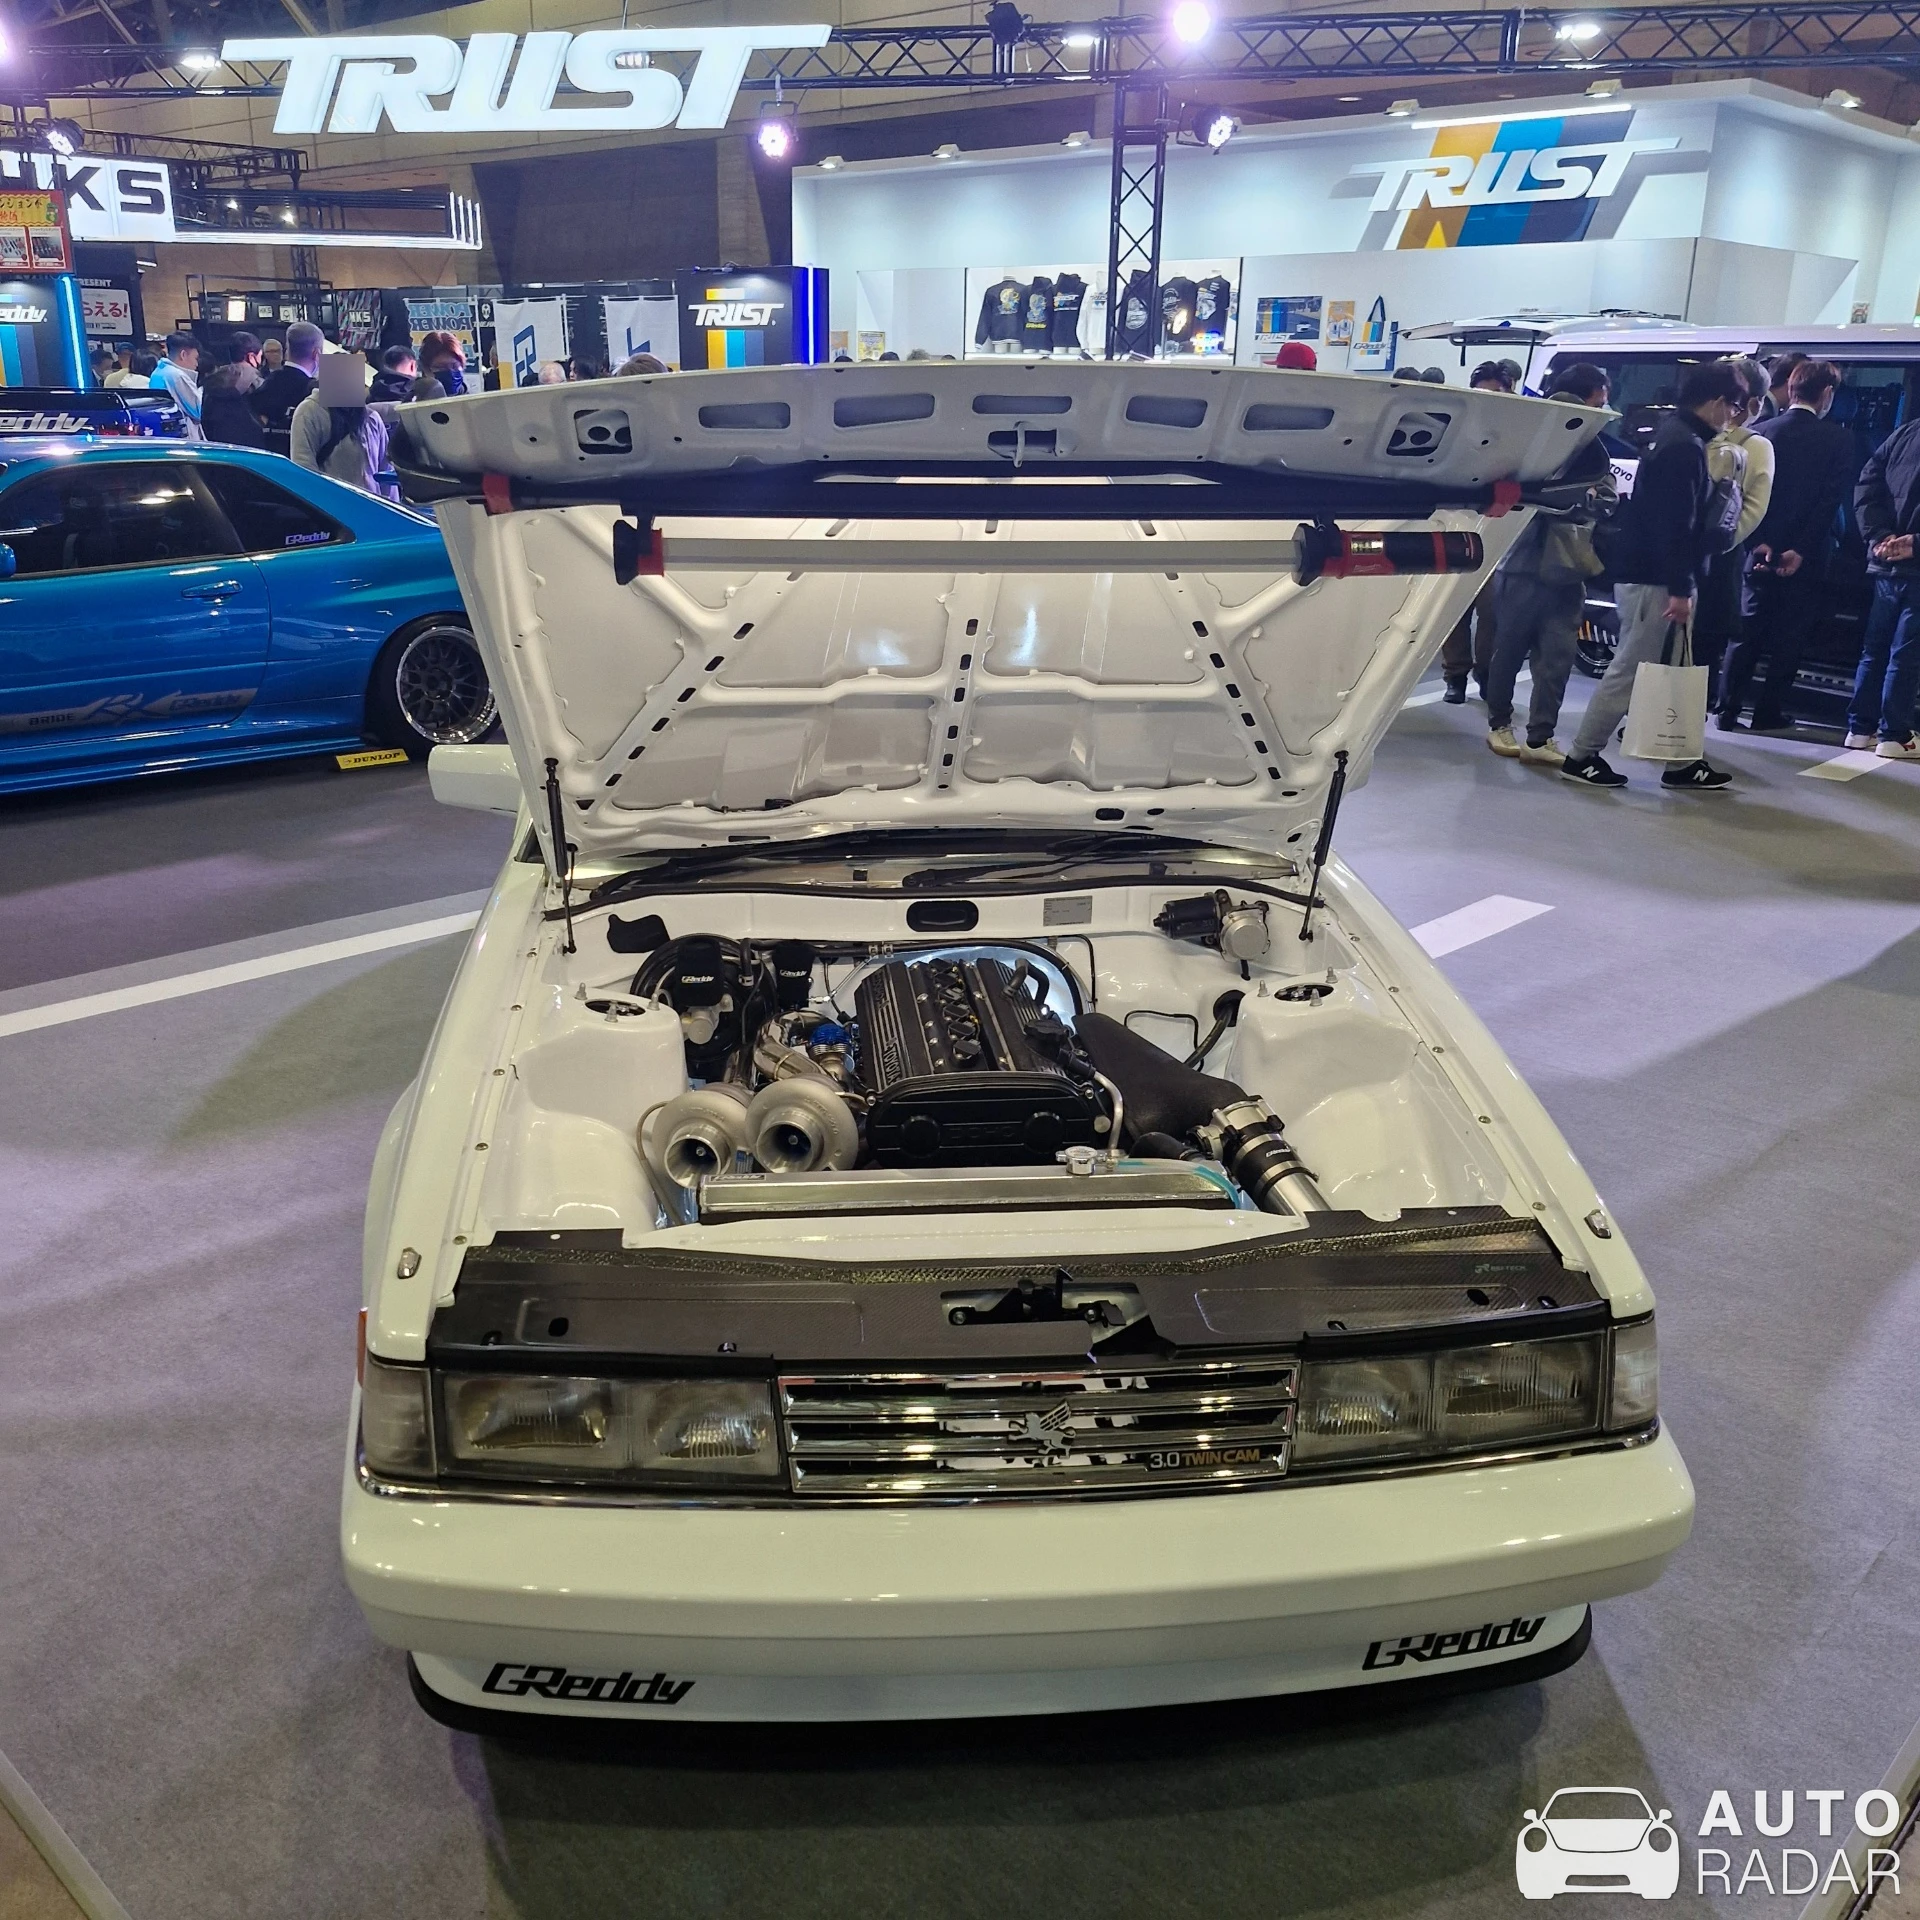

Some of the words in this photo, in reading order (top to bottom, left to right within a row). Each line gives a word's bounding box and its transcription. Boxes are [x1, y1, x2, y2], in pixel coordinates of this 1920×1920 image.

[221, 24, 832, 134] TRUST
[1350, 137, 1681, 212] TRUST
[688, 303, 784, 327] TRUST
[1610, 463, 1633, 482] TOYO
[285, 531, 330, 546] GReddy
[29, 712, 76, 727] BRIDE
[353, 752, 400, 764] DUNLOP
[681, 975, 715, 984] GReddy
[1149, 1451, 1180, 1469] 3.0
[1181, 1451, 1221, 1466] TWIN
[1222, 1448, 1260, 1463] CAM
[1364, 1618, 1546, 1670] GReddy
[482, 1663, 695, 1705] GReddy
